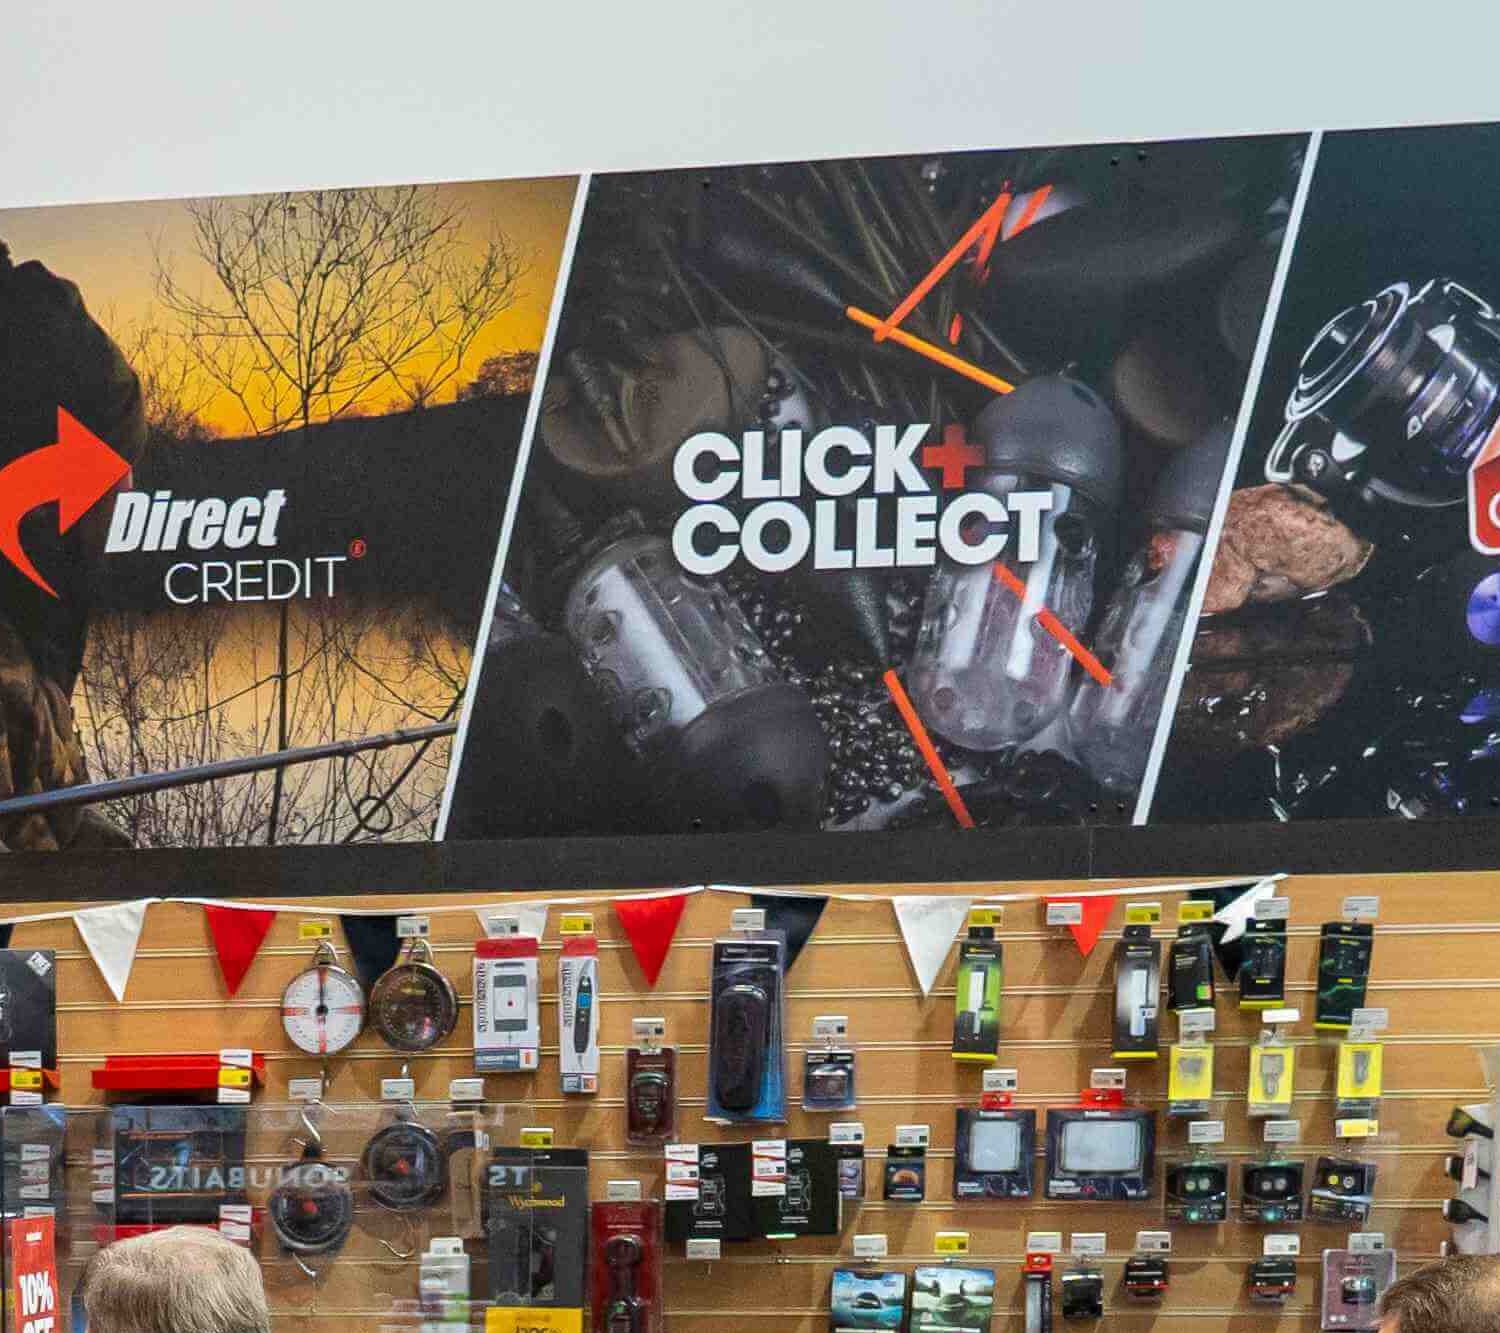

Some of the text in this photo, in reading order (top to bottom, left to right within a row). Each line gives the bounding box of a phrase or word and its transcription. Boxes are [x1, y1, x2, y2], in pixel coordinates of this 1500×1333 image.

[104, 489, 287, 553] Direct
[671, 490, 1052, 575] COLLECT
[164, 556, 347, 604] CREDIT
[19, 1271, 54, 1316] 10%
